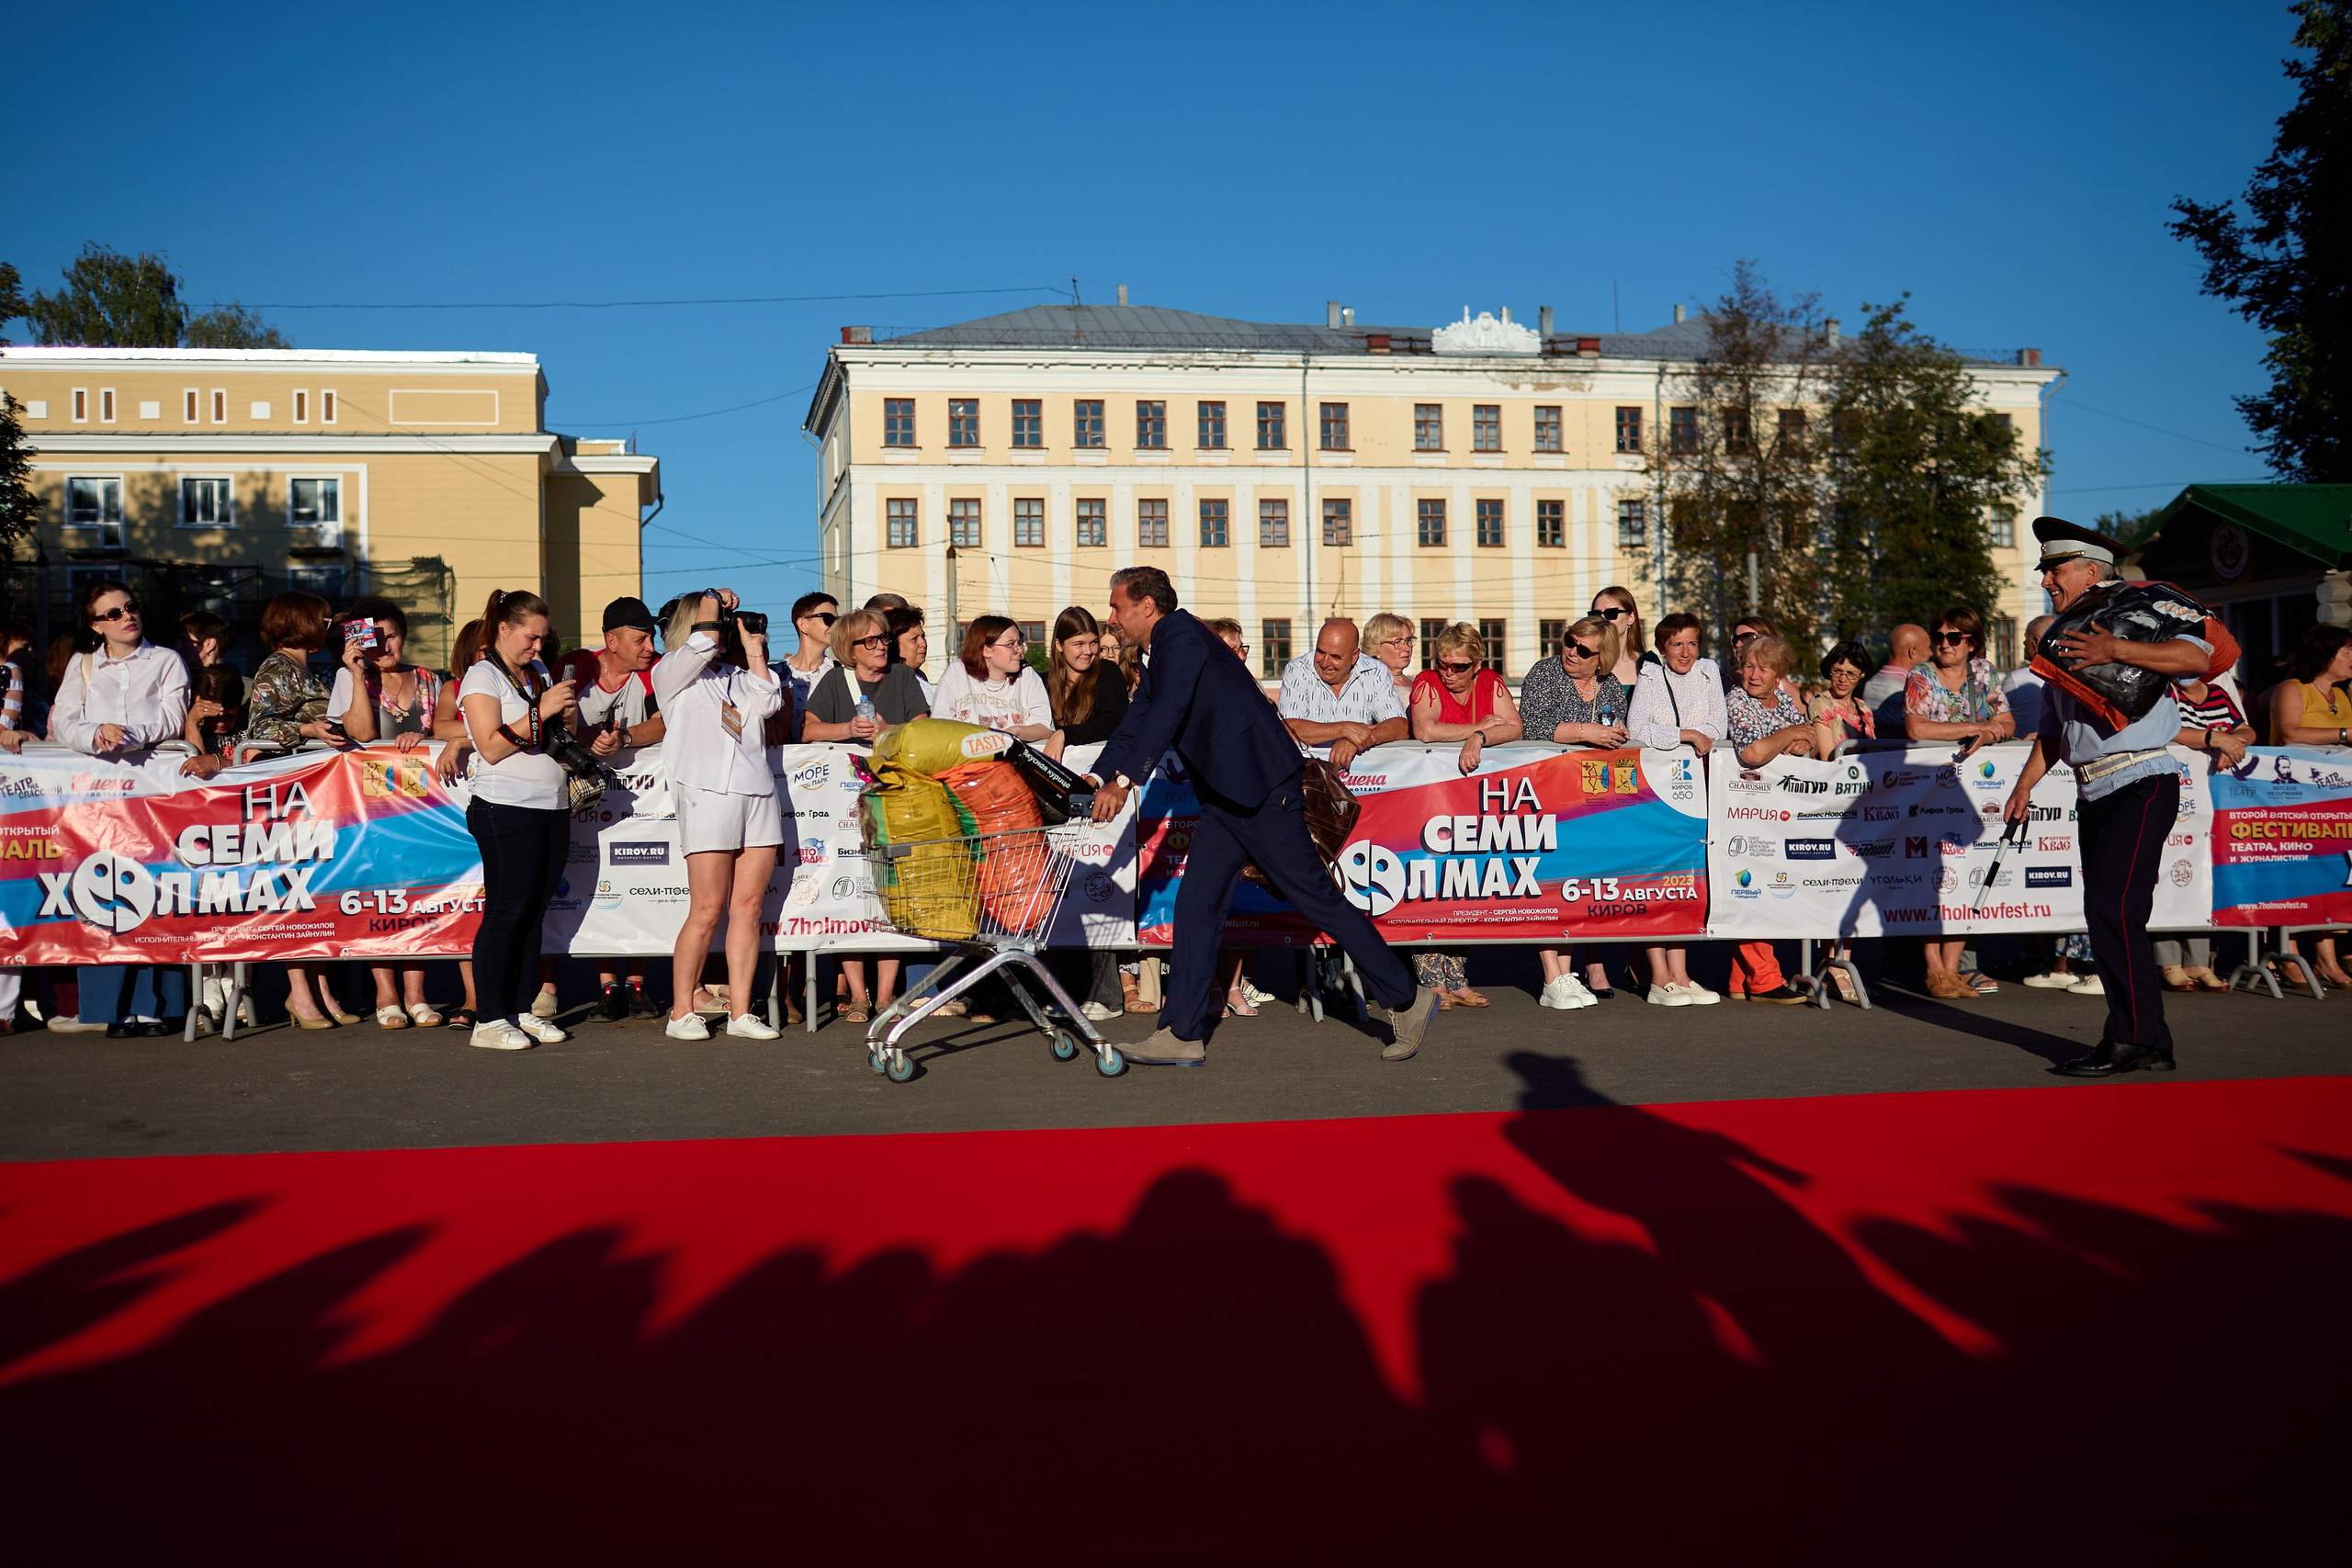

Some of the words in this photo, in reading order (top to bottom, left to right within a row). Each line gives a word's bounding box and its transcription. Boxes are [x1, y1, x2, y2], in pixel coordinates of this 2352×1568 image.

[794, 764, 830, 784] МОРЕ
[1023, 749, 1047, 773] Вкусная
[1047, 768, 1071, 789] курица
[1936, 765, 1962, 784] МОРЕ
[812, 777, 829, 786] ПАРК
[2316, 773, 2339, 789] ТЕАТР
[2329, 781, 2352, 790] СПАССК
[1728, 782, 1771, 792] CHARUSHIN
[1835, 781, 1874, 795] ВЯТИЧ
[2229, 788, 2256, 796] ТЕАТР
[1481, 777, 1542, 812] НА
[1672, 791, 1693, 800] 650
[246, 783, 316, 820] НА
[2177, 799, 2196, 813] ОРЕ
[808, 810, 830, 819] Град
[1727, 807, 1778, 821] МАРИЯ
[1920, 807, 1944, 815] Киров
[1947, 805, 1964, 813] Град
[2230, 809, 2267, 819] ВТОРОЙ
[2269, 810, 2309, 820] ВЯТСКИЙ
[2310, 812, 2352, 820] ОТКРЫТЫ
[1423, 814, 1557, 852] СЕМИ
[180, 820, 334, 865] СЕМИ
[1789, 843, 1831, 852] KIROV.RU
[2230, 842, 2278, 852] ТЕАТРА,
[2279, 842, 2313, 852] КИНО
[614, 848, 664, 856] KIROV.RU
[2240, 854, 2308, 863] ЖУРНАЛИСТИКИ
[1662, 875, 1694, 886] 2023
[2029, 871, 2068, 880] KIROV.RU
[629, 886, 690, 896] сели-пое
[1562, 878, 1620, 902] 6-13
[1622, 887, 1698, 901] АВГУСТА
[340, 889, 408, 915] 6-13
[411, 897, 486, 914] АВГУСТ
[2237, 901, 2308, 910] www.7holmovfest.ru
[1588, 904, 1646, 917] КИРОВ
[257, 924, 285, 932] СЕРГЕЙ
[286, 922, 335, 931] НОВОЖИЛОВ
[369, 917, 439, 931] КИРОВ
[246, 932, 295, 941] КОНСТАНТИН
[296, 931, 335, 939] ЗАЙНУЛИН
